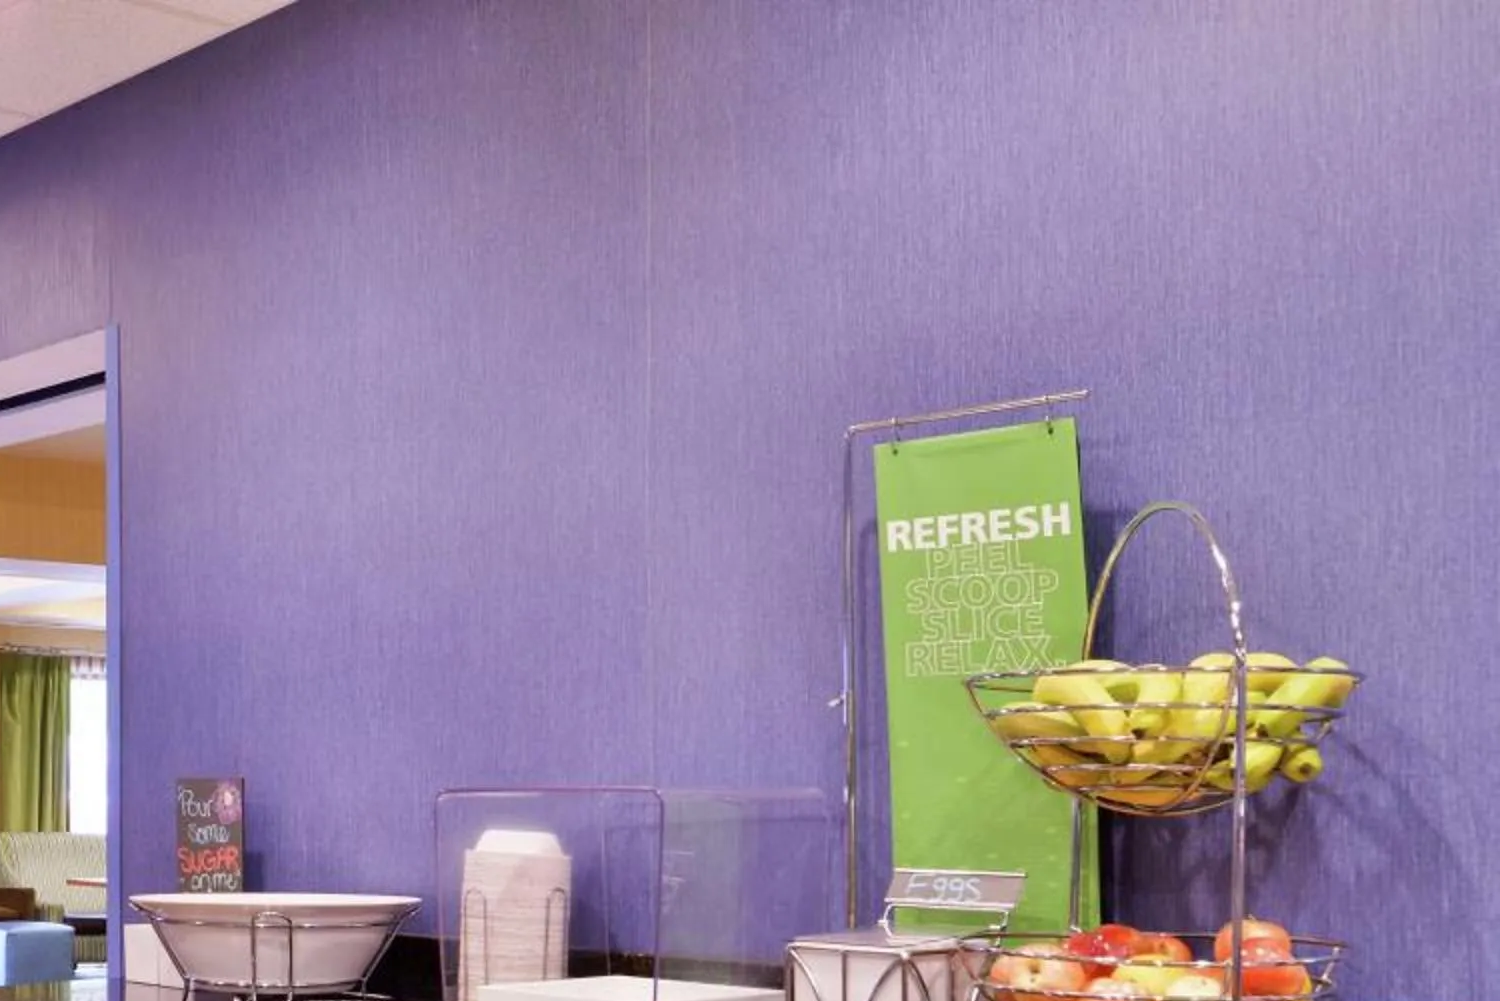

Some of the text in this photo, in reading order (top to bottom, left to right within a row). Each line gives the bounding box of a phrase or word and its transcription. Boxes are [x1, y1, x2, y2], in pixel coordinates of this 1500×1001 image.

[886, 501, 1072, 553] REFRESH
[926, 540, 1033, 581] PEEL
[905, 569, 1059, 614] SCOOP
[922, 604, 1045, 644] SLICE
